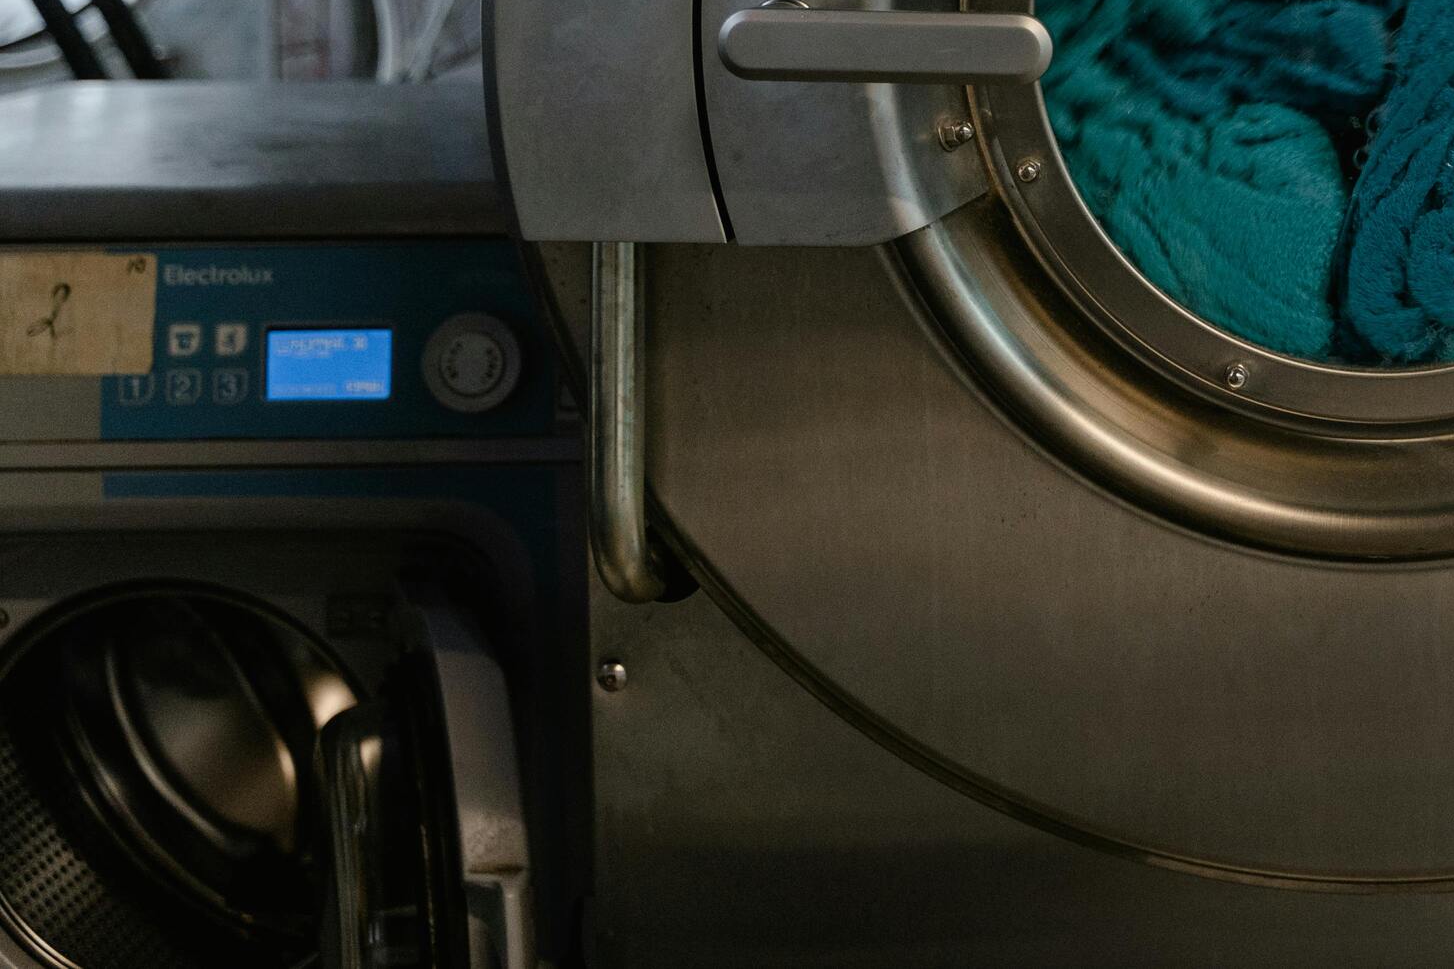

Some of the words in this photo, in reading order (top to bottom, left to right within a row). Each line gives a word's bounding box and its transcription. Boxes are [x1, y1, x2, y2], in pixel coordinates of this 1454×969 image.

[164, 263, 274, 287] Electrolux
[174, 373, 192, 401] 2
[219, 373, 239, 399] 3
